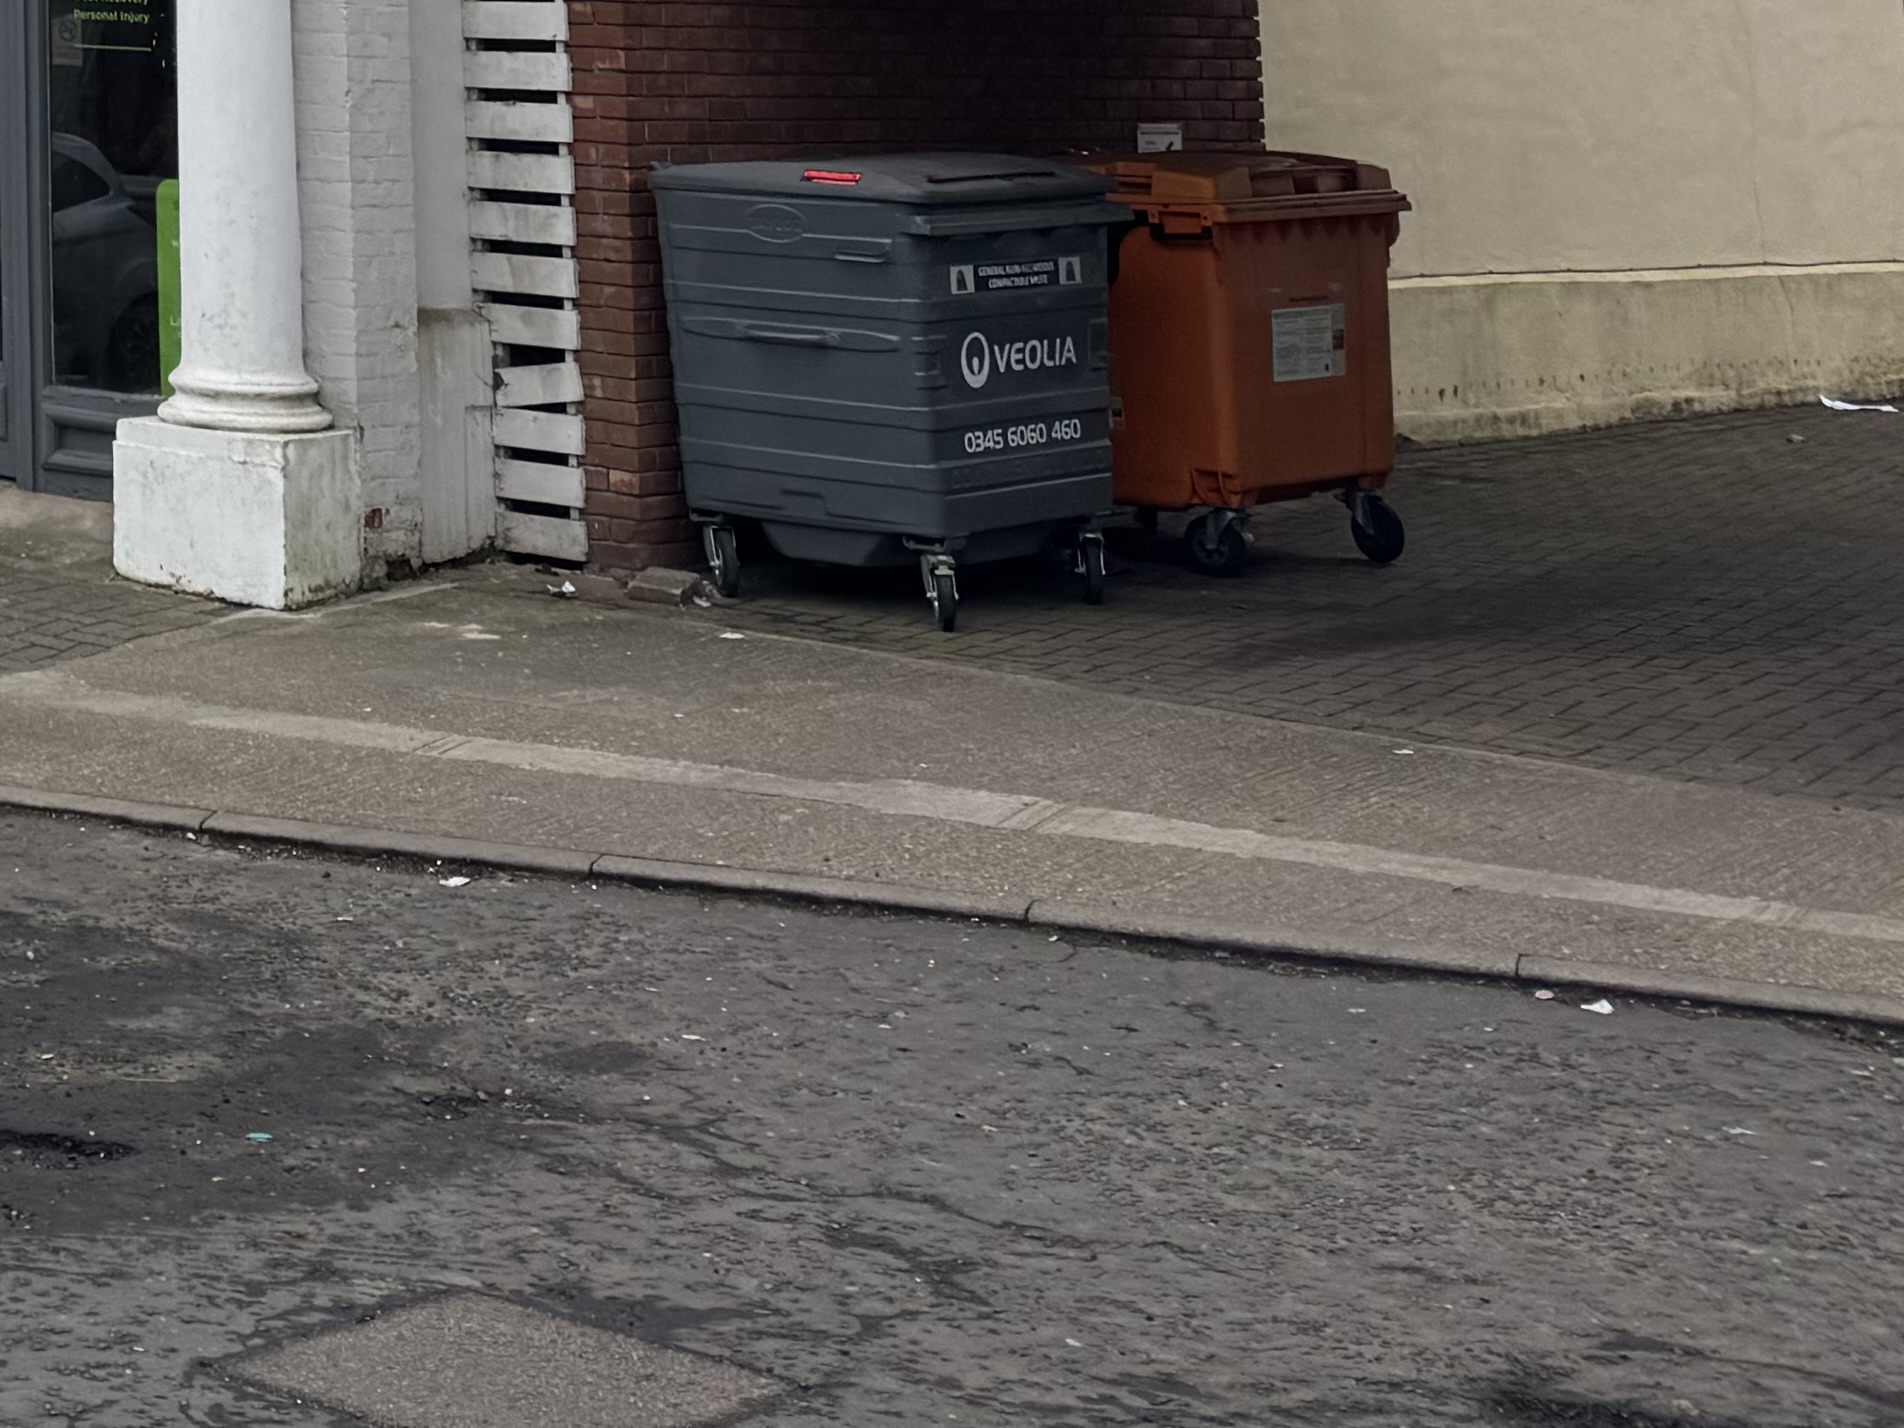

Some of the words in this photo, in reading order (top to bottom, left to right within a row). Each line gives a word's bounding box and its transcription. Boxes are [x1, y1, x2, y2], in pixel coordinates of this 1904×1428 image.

[73, 8, 118, 21] Personal
[120, 11, 150, 24] Injury
[994, 336, 1077, 373] VEOLIA
[1007, 423, 1047, 447] 6060
[1051, 418, 1081, 441] 460
